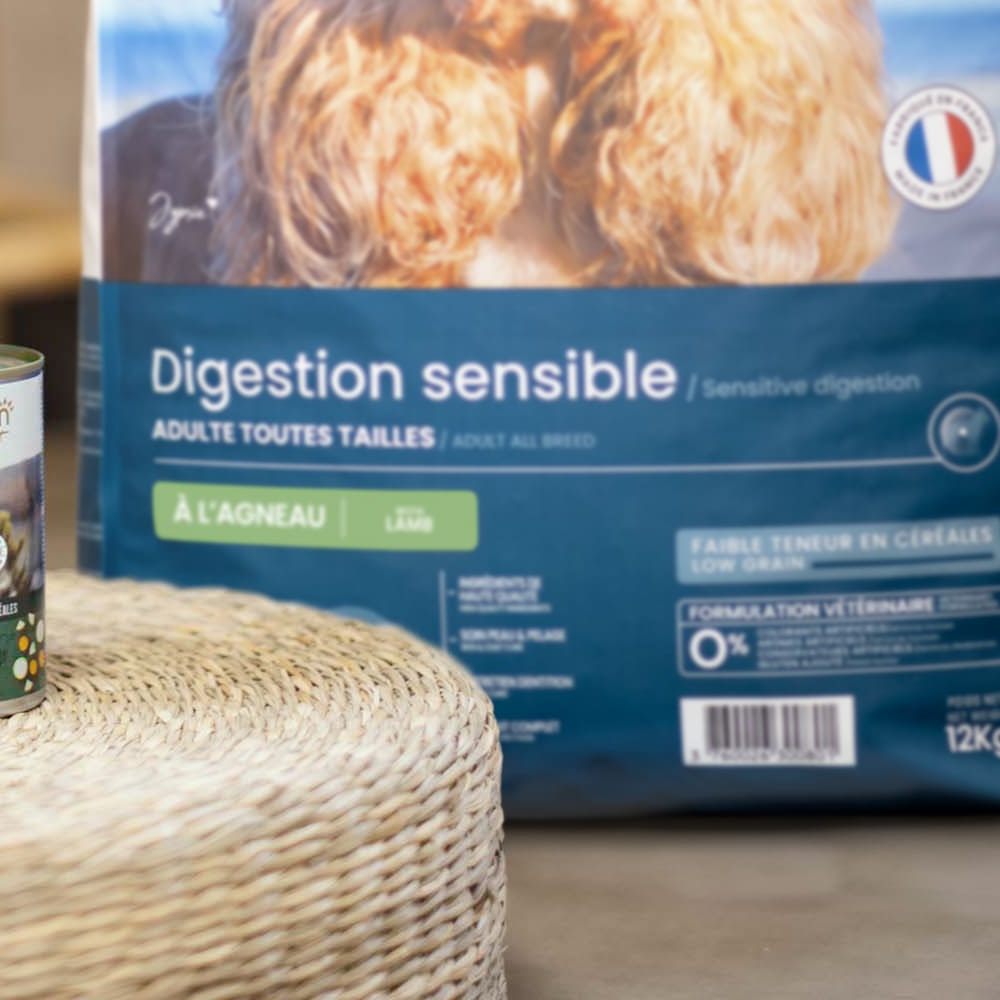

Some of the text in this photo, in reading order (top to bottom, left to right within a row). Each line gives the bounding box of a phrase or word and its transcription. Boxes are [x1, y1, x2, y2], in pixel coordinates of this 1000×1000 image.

[151, 346, 403, 412] Digestion
[421, 348, 679, 401] sensible
[702, 376, 808, 399] Sensitive
[814, 372, 921, 401] digestion
[151, 418, 235, 443] ADULTE
[240, 421, 333, 447] TOUTES
[338, 424, 436, 449] TAILLES
[173, 493, 326, 529] À L'AGNEAU
[385, 515, 434, 533] LAMB
[690, 524, 994, 555] FAIBLE TENEUR EN CÉRÉALES
[690, 556, 806, 574] LOW GRAIN
[688, 600, 820, 621] FORMULATION
[824, 595, 935, 619] VÉTÉRINAIRE
[688, 628, 749, 669] 0%
